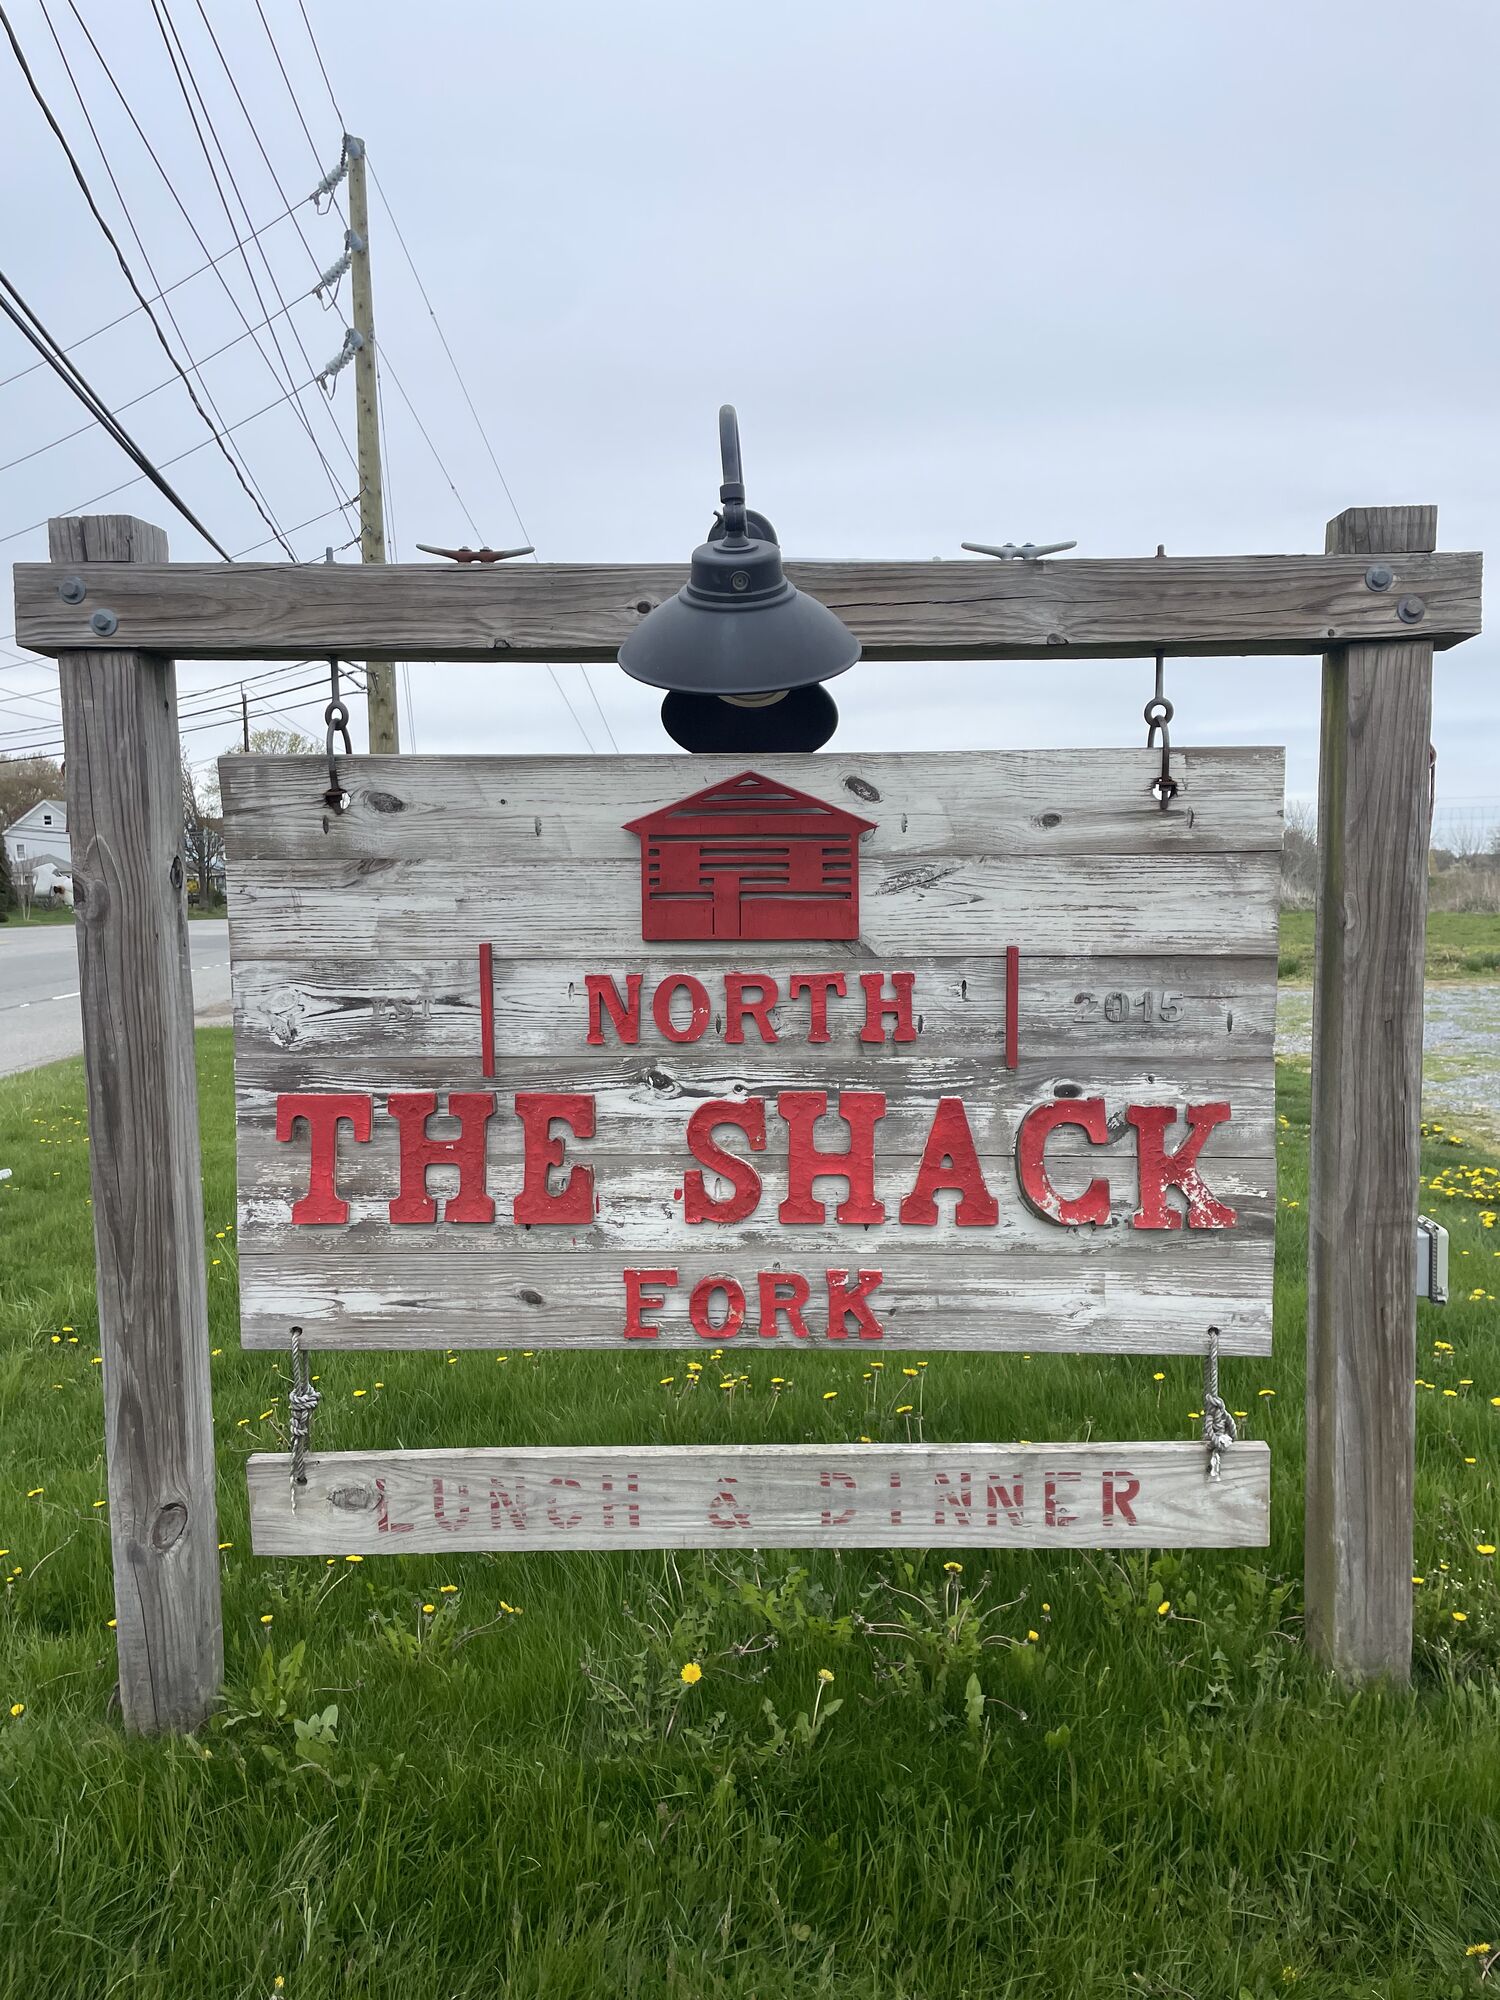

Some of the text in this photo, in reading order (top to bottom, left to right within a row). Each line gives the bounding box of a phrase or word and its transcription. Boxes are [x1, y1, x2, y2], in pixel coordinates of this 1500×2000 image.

[370, 992, 436, 1022] EST
[585, 972, 917, 1045] NORTH
[1073, 990, 1186, 1023] 2015
[276, 1090, 1239, 1231] THE SHACK
[623, 1266, 884, 1341] FORK
[375, 1471, 1141, 1533] LUNCH & DINNER
